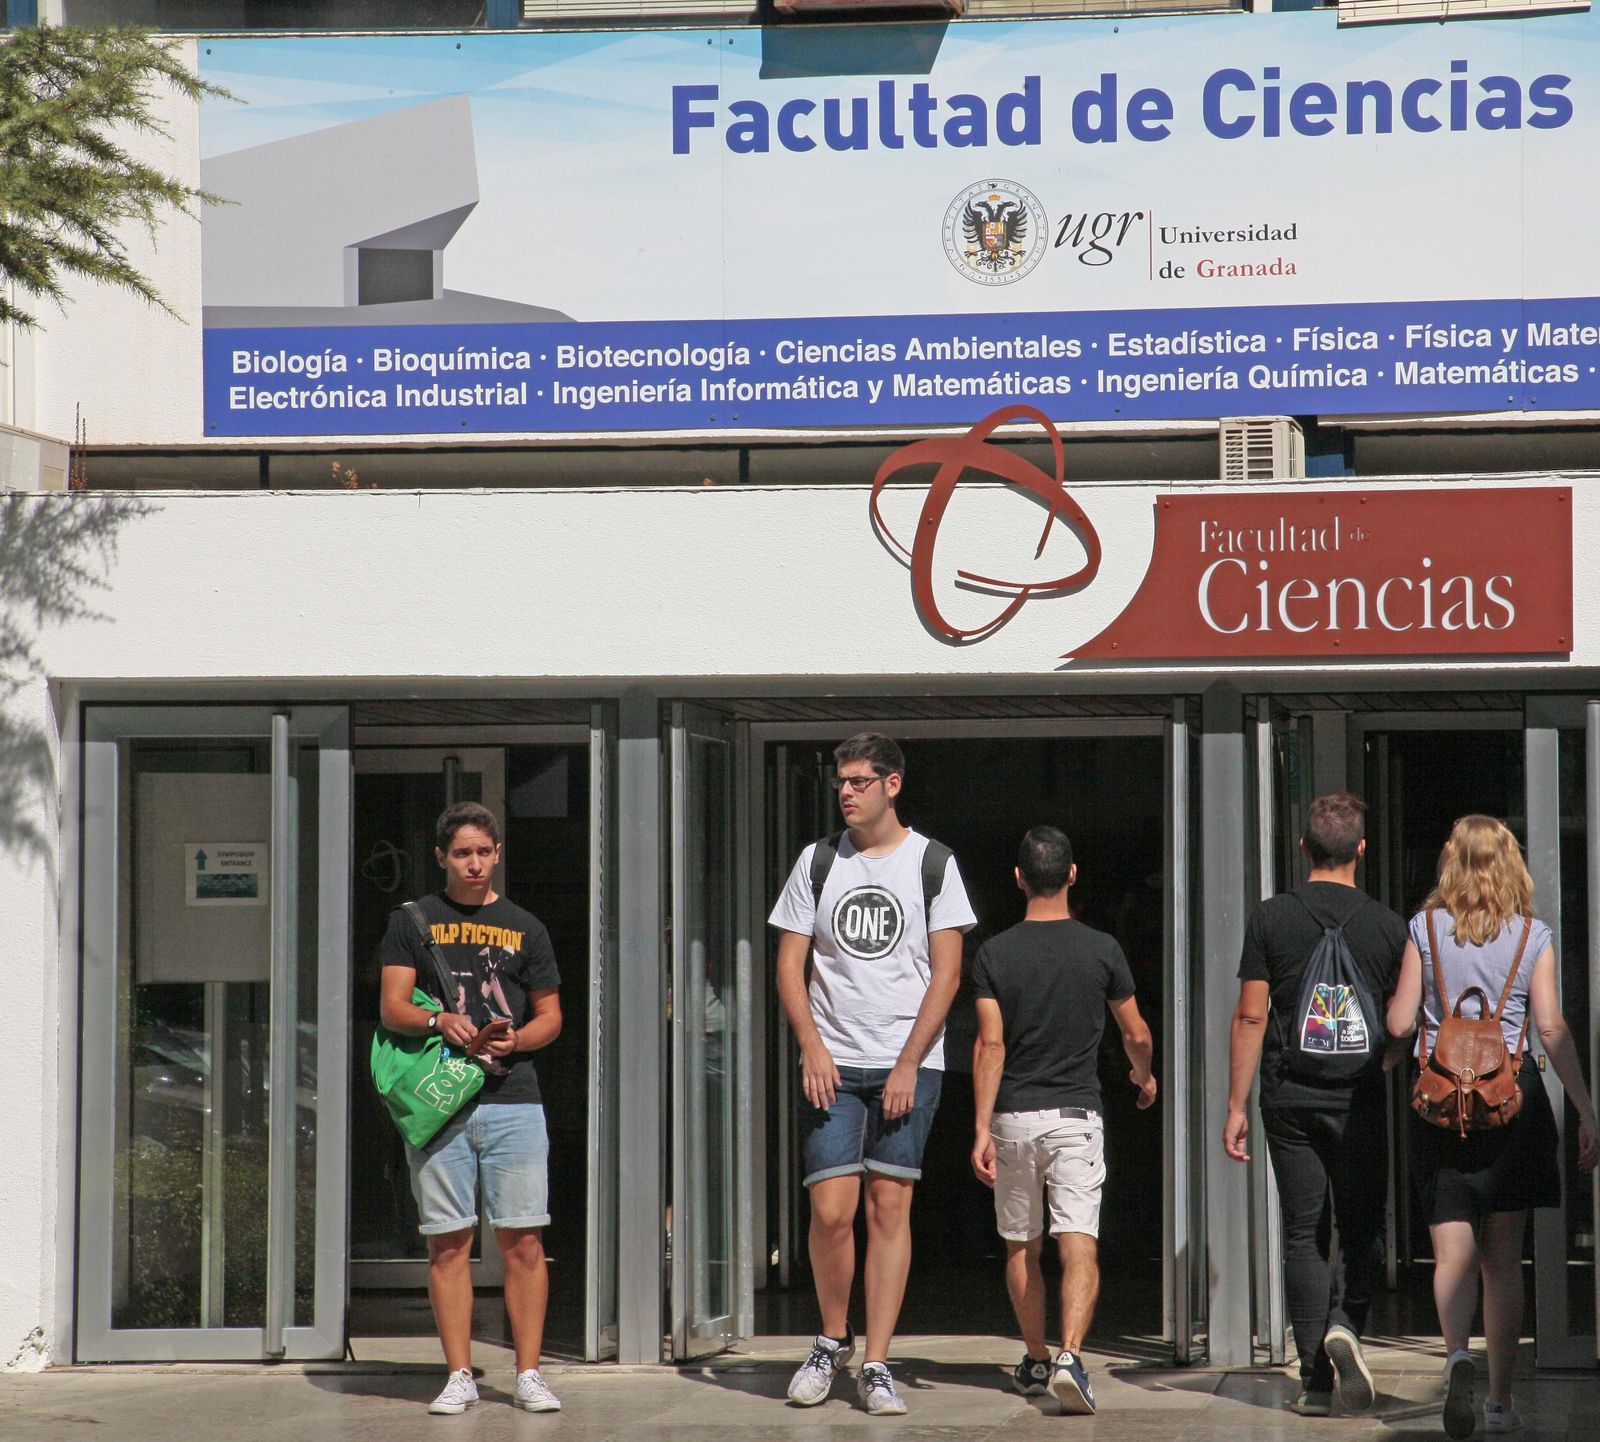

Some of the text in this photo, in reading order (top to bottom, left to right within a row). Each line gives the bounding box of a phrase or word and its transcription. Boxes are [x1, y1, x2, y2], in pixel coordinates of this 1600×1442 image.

[673, 62, 1572, 154] Facultad de Ciencias
[1054, 211, 1144, 266] ugr
[1159, 222, 1298, 245] Universidad
[1159, 258, 1297, 279] de Granada
[232, 322, 1600, 379] Biología Bioquímica Biotecnología Ciencias Ambientales Estadística Física Física y Mate
[229, 359, 1579, 411] Electrónica Industrial Ingeniería Informática y Matemáticas Ingeniería Química Matemáticas
[1199, 516, 1370, 553] Facultad de
[1198, 557, 1515, 633] Ciencias
[431, 922, 522, 951] ULP FICTION
[845, 905, 890, 941] ONE
